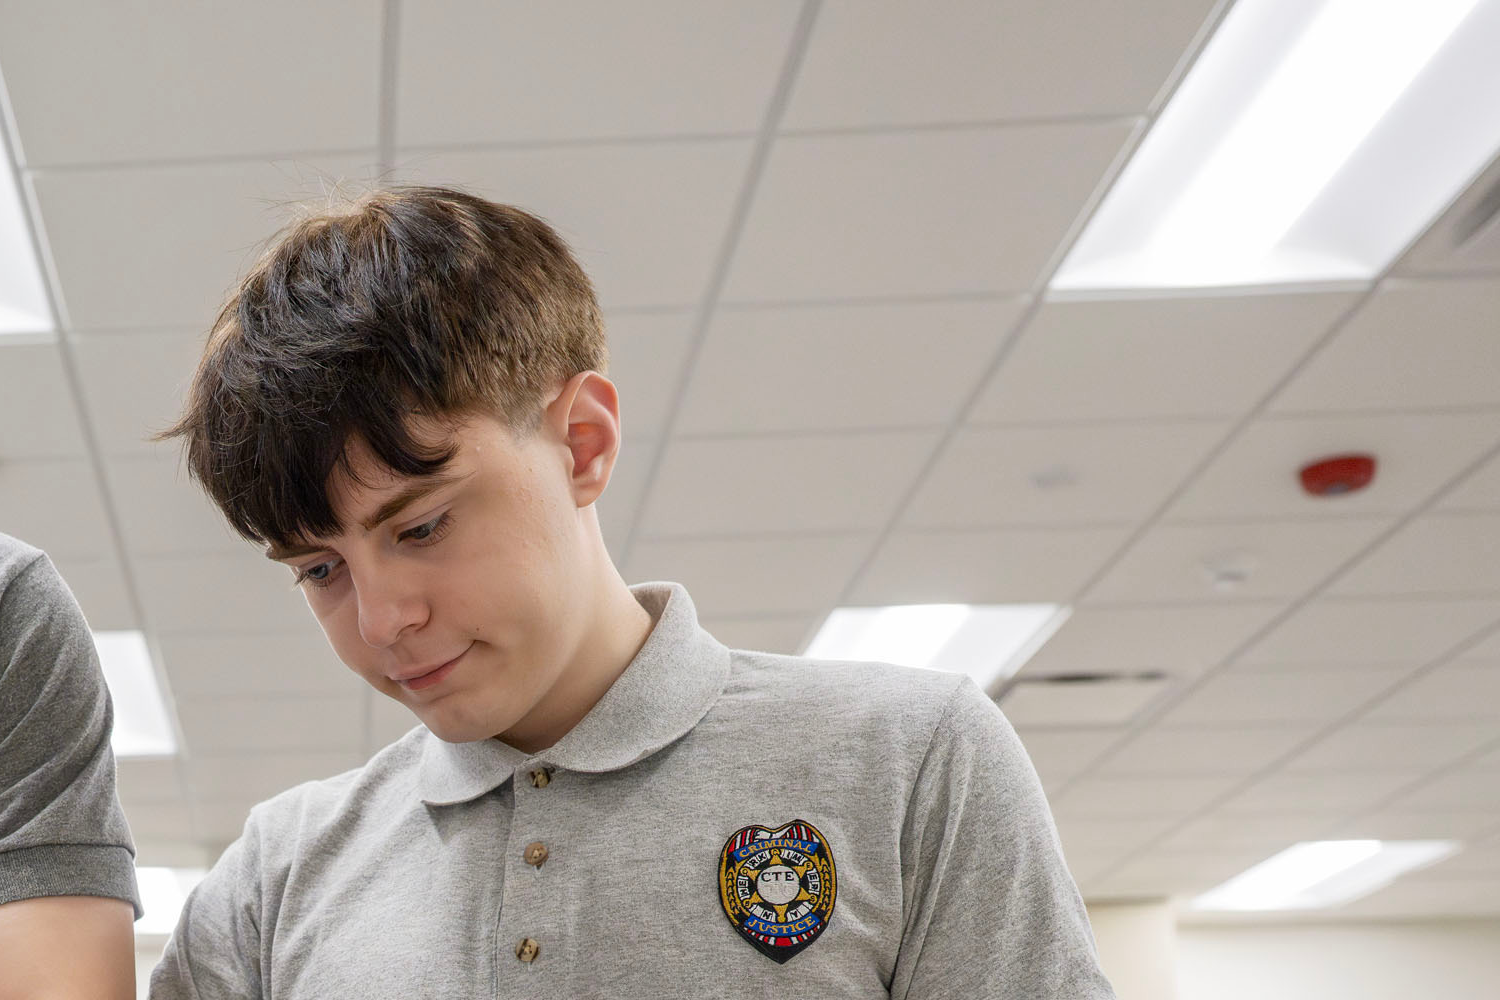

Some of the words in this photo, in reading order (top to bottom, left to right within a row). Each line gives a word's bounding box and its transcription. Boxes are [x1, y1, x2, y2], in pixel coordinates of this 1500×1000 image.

[739, 839, 812, 858] CRIMINAL
[761, 871, 795, 883] CTE
[748, 916, 816, 934] JUSTICE
